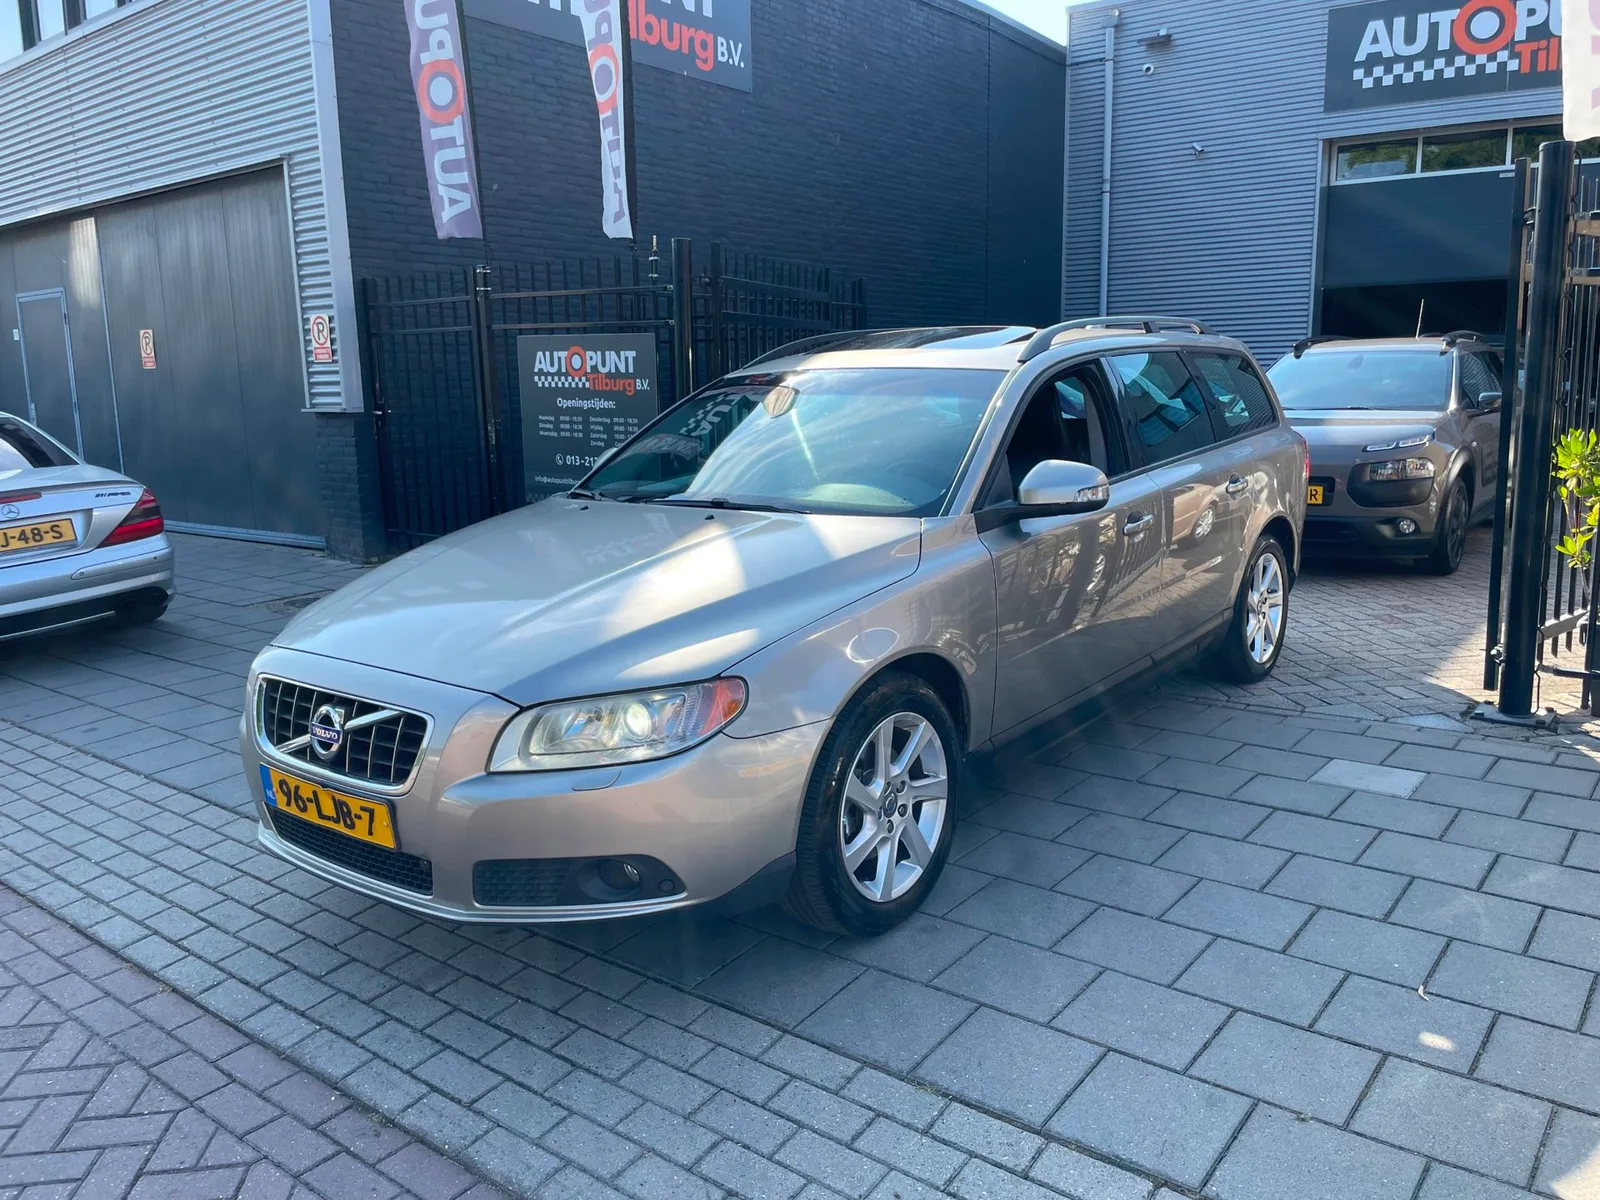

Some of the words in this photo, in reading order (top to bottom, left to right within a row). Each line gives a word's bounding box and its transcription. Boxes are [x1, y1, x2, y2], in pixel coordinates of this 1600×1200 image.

[628, 0, 715, 71] lburg
[717, 36, 745, 68] B.V.
[1515, 37, 1562, 74] Til
[534, 345, 636, 378] AUTOPUNT
[587, 373, 636, 396] Tilburg
[636, 378, 650, 390] B.V.
[556, 397, 616, 410] Openingstijden:
[312, 726, 338, 741] VOLVO
[278, 778, 375, 836] 96-LJB-7
